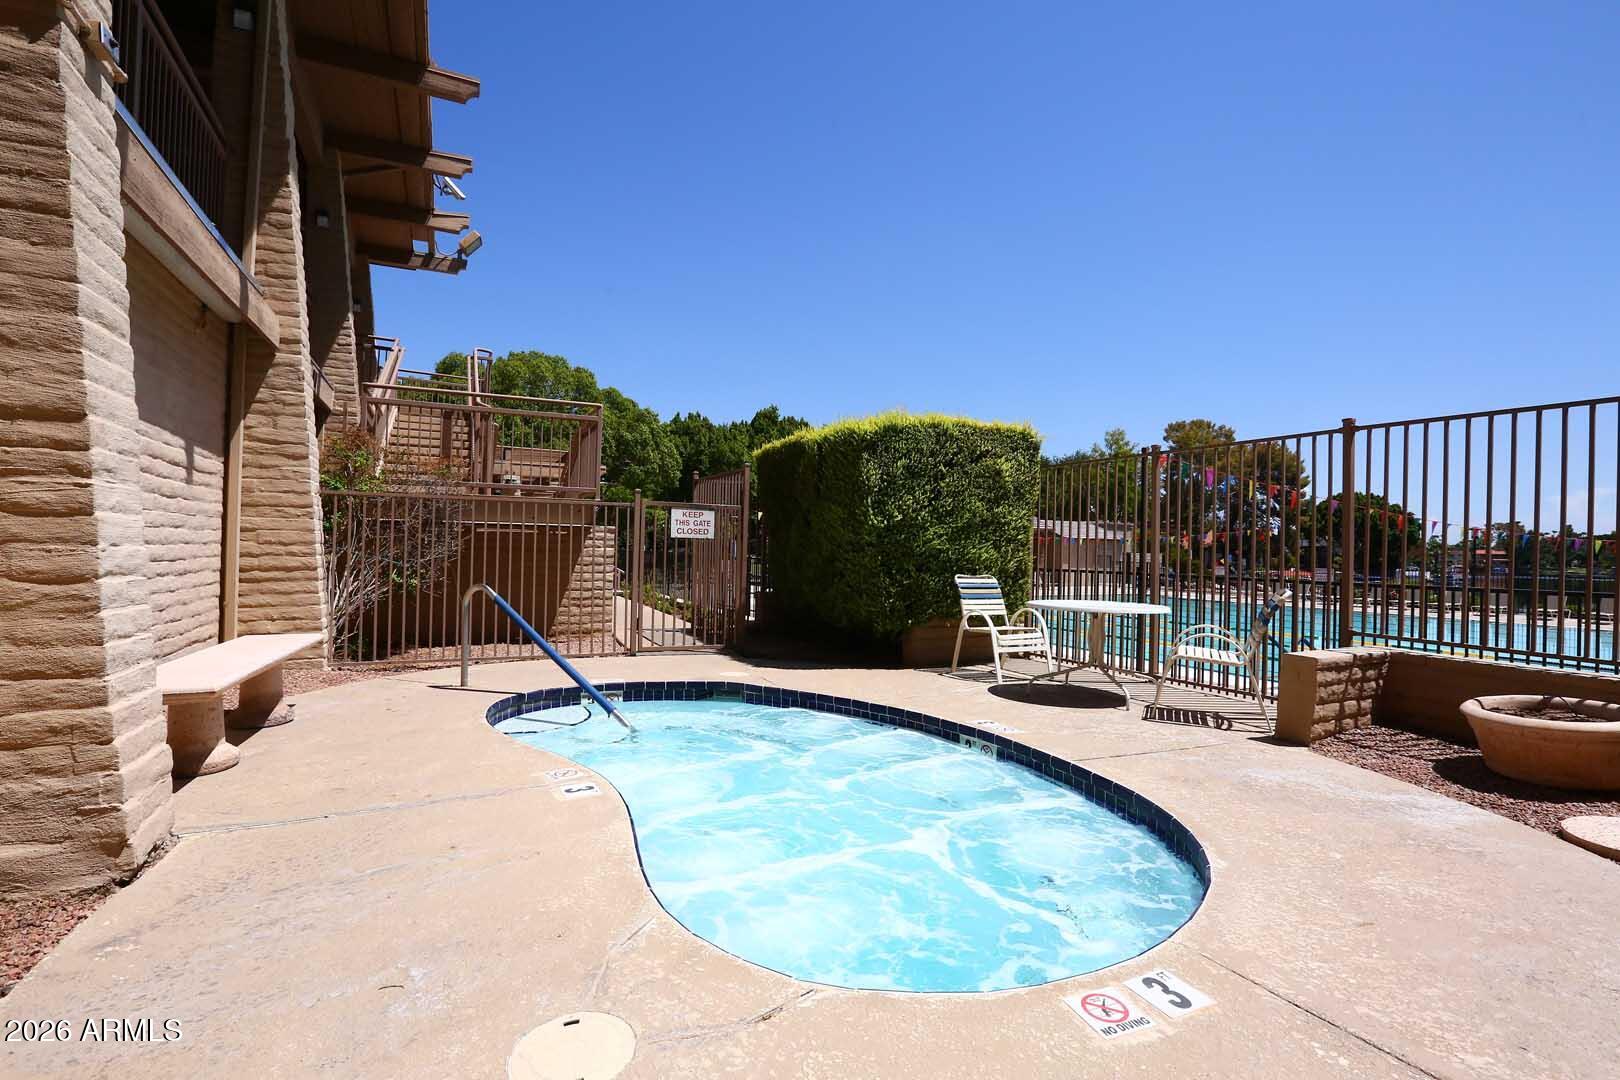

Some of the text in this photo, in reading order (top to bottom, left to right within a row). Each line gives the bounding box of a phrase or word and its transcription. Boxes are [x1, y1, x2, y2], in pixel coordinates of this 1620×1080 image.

[682, 511, 704, 519] KEEP
[675, 519, 712, 527] THIS GATE
[676, 528, 709, 536] CLOSED
[1142, 976, 1192, 1009] 3
[1100, 1016, 1151, 1037] NO DIVING
